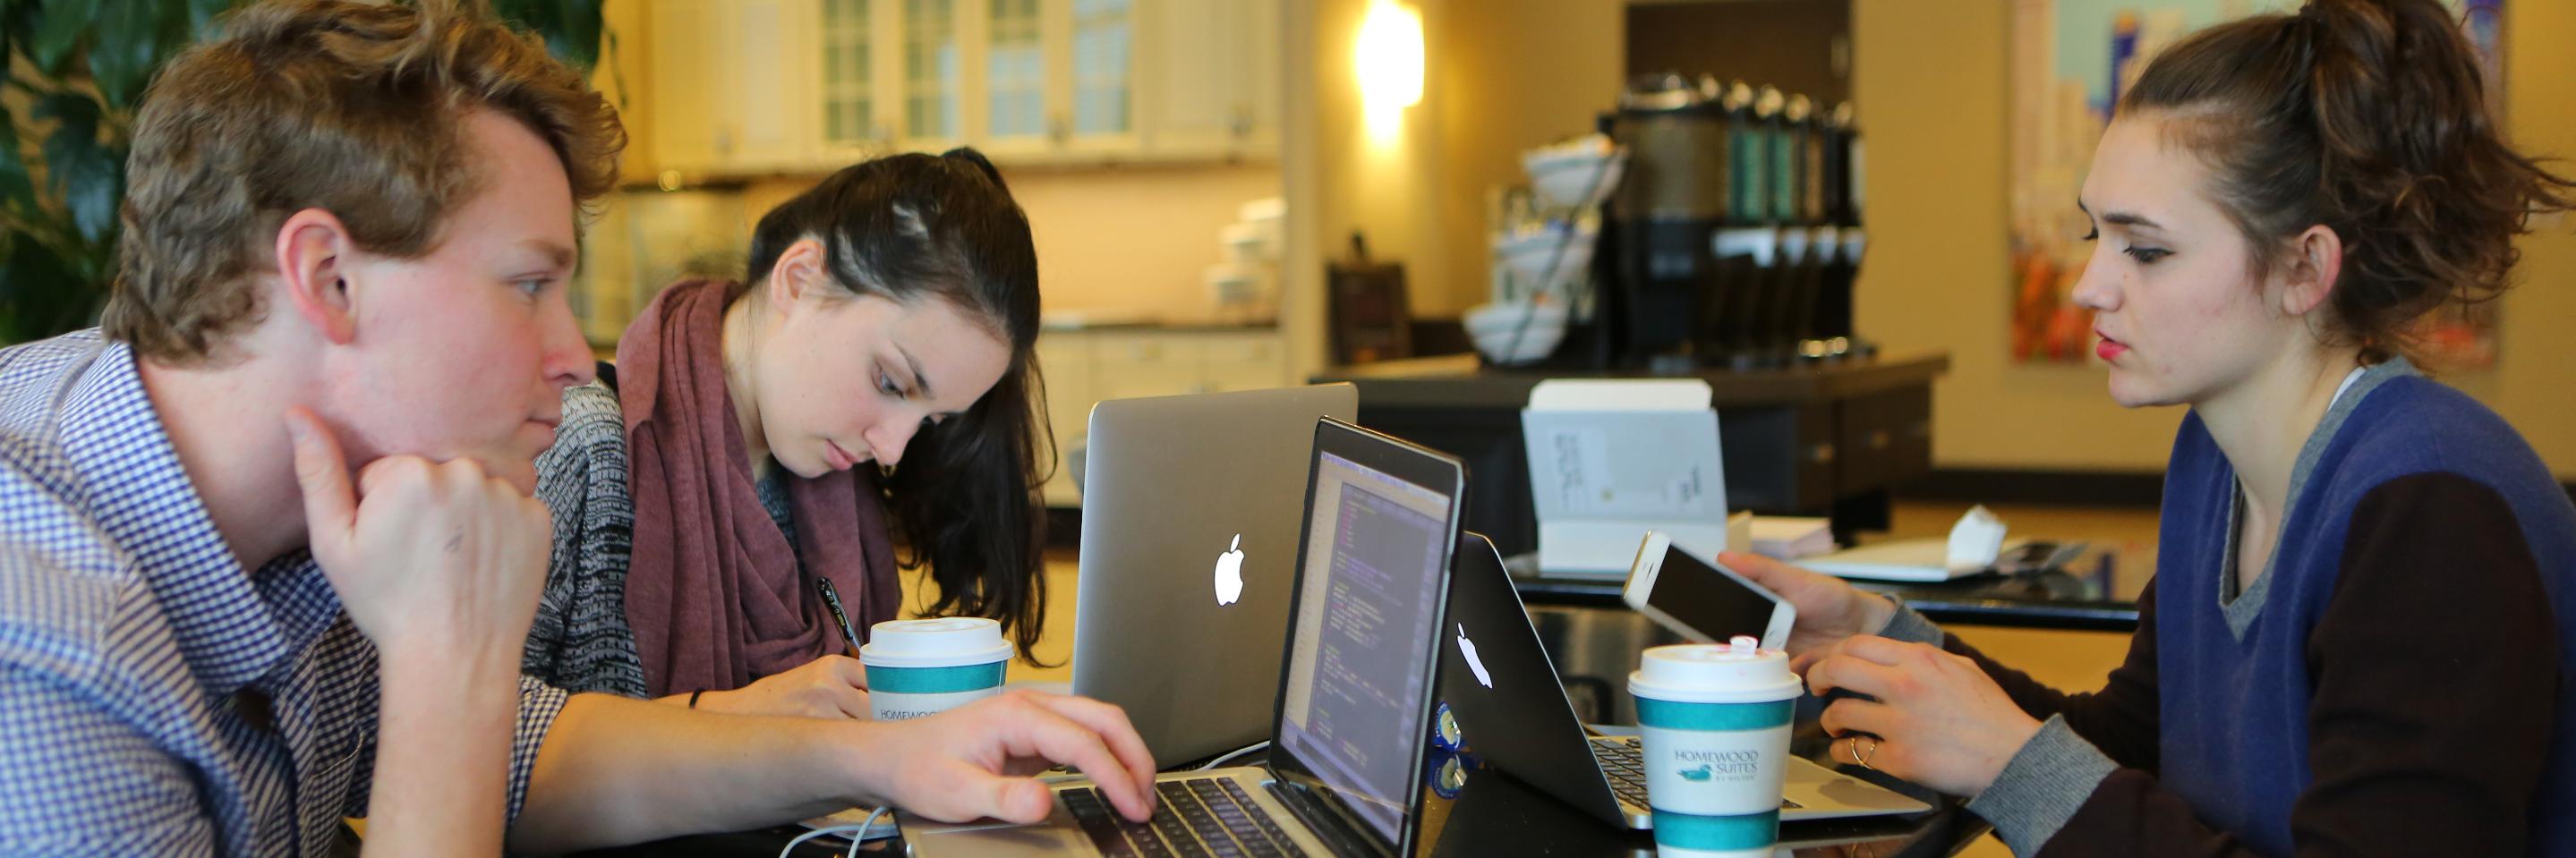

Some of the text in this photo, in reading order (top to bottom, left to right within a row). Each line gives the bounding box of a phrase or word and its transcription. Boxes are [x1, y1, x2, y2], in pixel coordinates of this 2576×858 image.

[881, 709, 938, 720] HOMEWO
[1675, 750, 1759, 762] HOMEWOOD
[1716, 763, 1758, 774] SUITES
